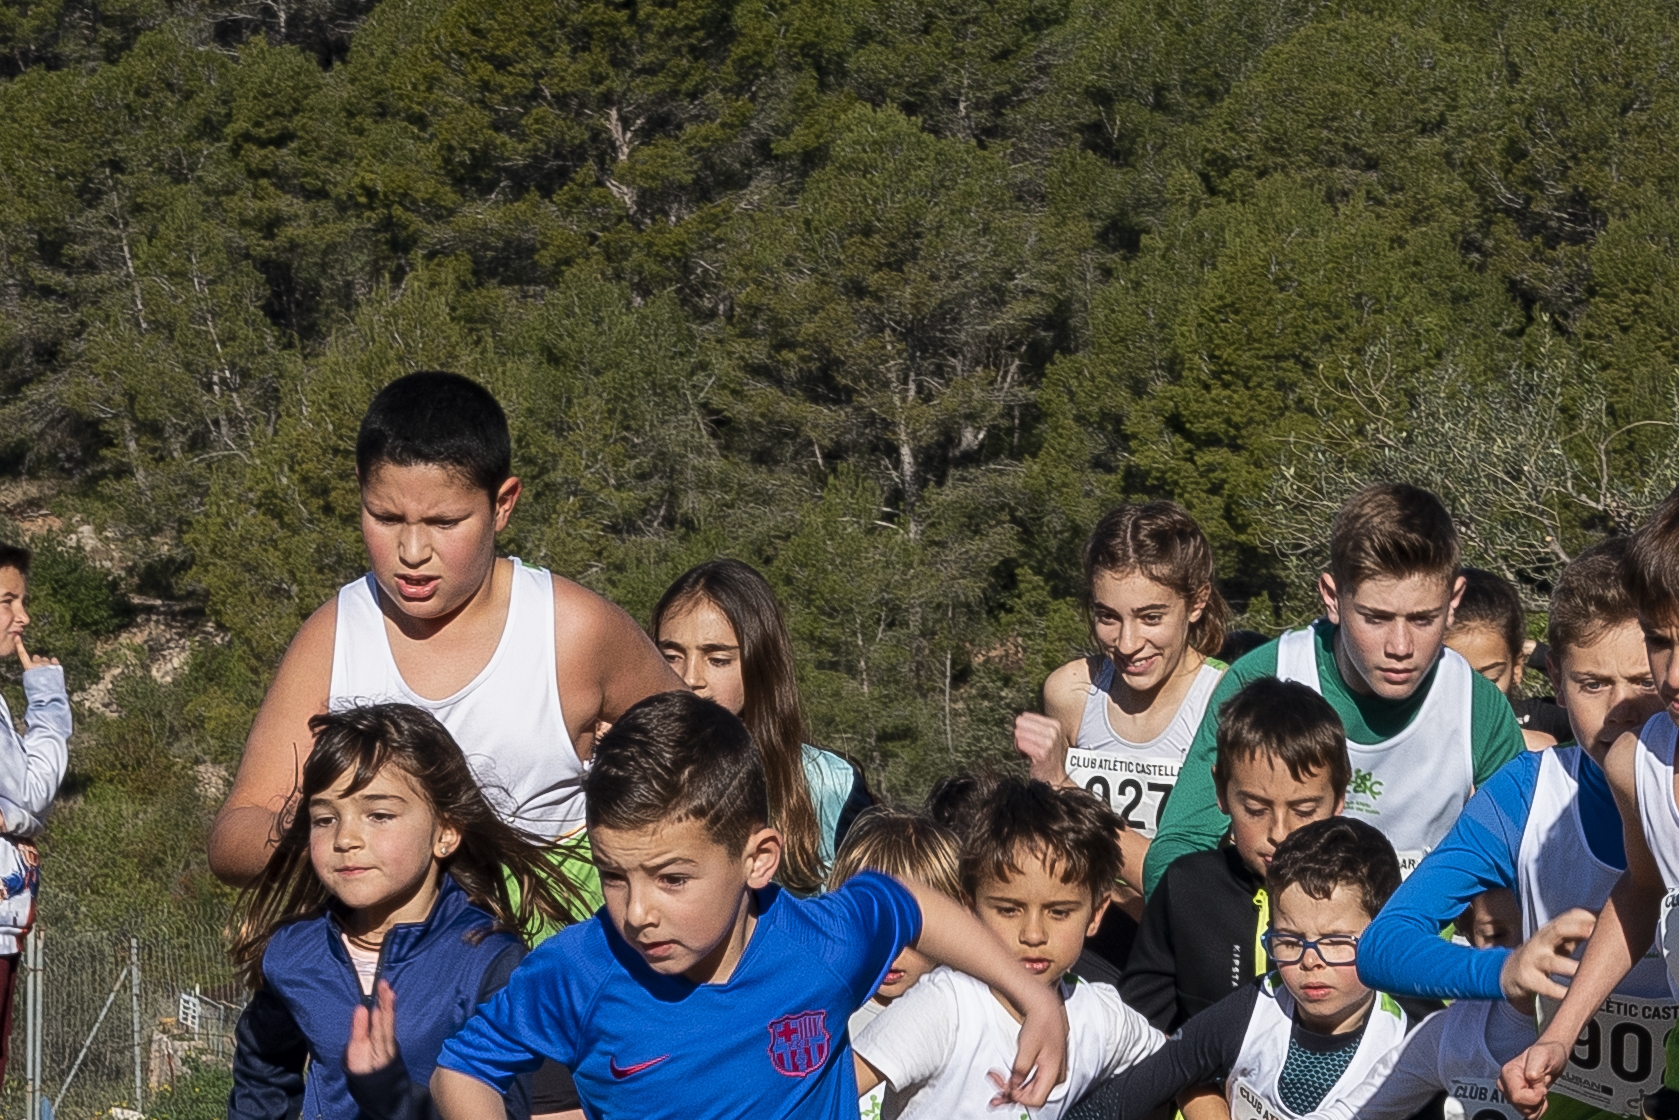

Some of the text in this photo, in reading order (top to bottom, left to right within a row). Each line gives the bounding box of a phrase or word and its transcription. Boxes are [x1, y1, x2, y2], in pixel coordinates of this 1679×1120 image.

[1070, 755, 1183, 777] CLUB ATLÈTIC CASTELL
[1239, 1086, 1263, 1115] CLUB
[1454, 1085, 1488, 1101] CLUB
